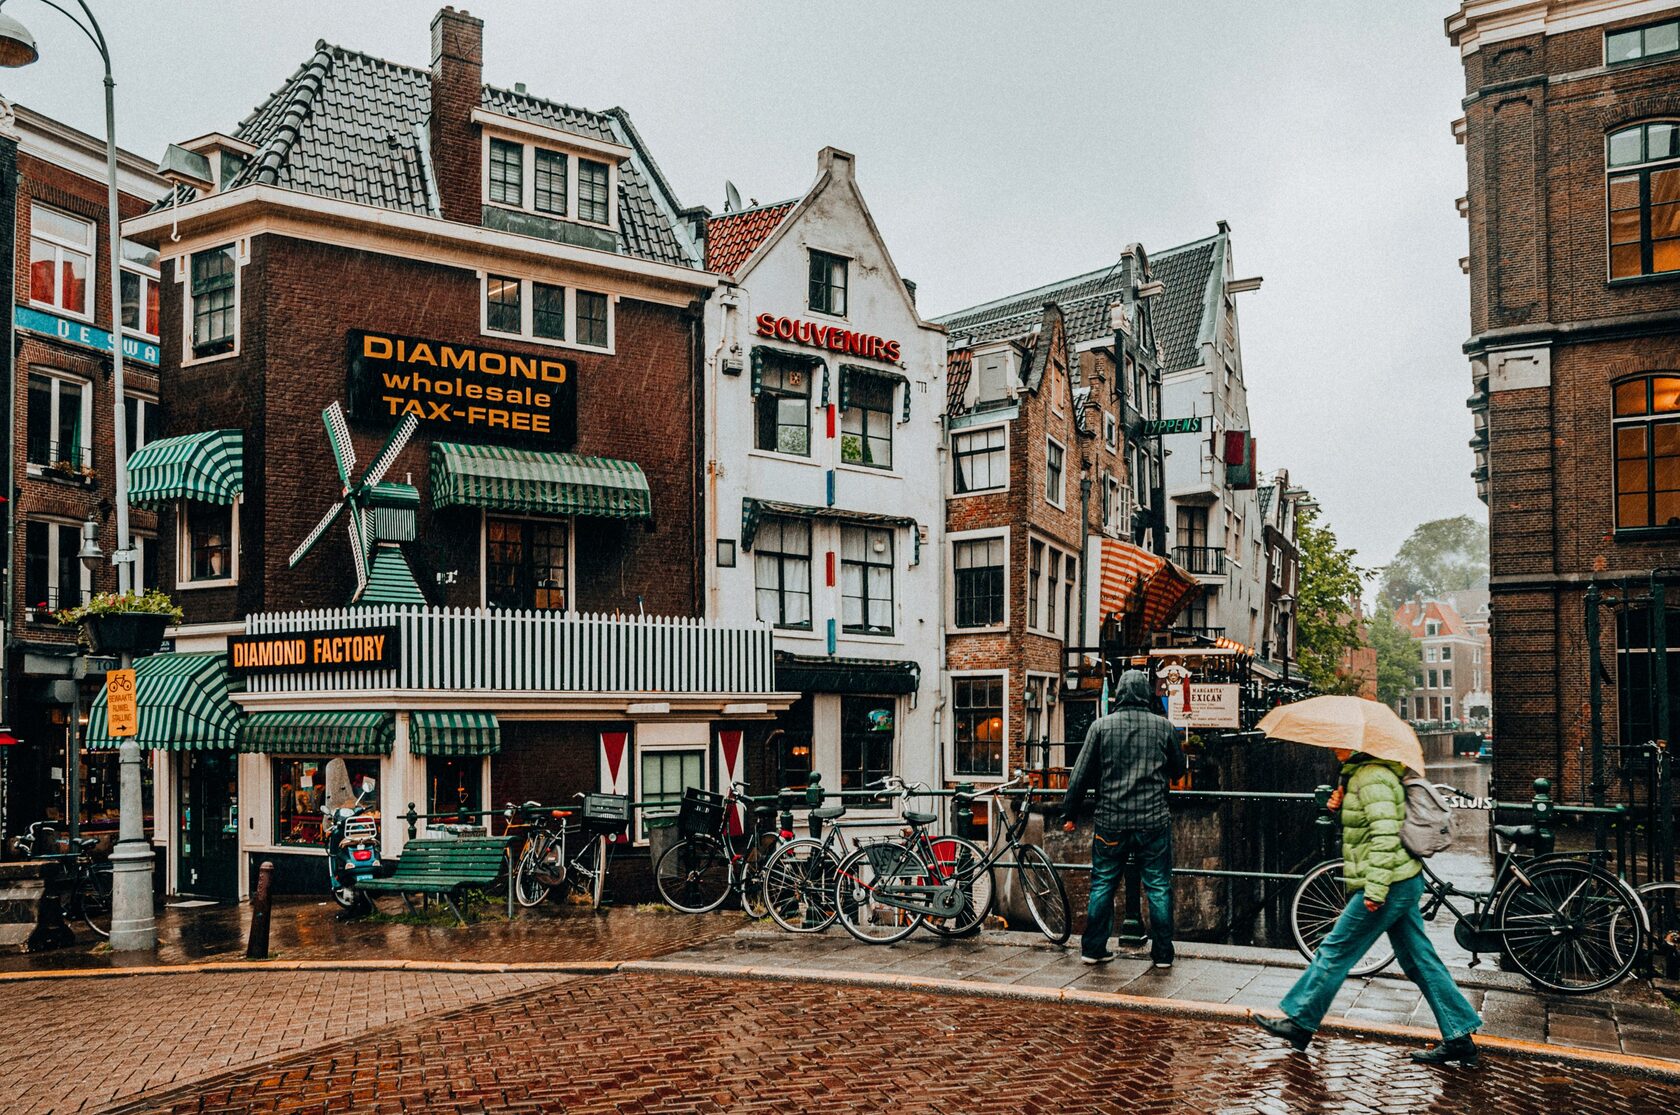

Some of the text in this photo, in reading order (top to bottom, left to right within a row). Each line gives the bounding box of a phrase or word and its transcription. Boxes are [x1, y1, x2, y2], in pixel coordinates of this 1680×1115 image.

[57, 318, 91, 343] DE
[756, 312, 901, 362] SOUVENIRS
[363, 335, 567, 384] DIAMOND
[382, 371, 551, 408] wholesale
[382, 396, 551, 433] TAX-FREE
[233, 634, 385, 667] DIAMOND FACTORY
[1191, 694, 1222, 702] EXICAN
